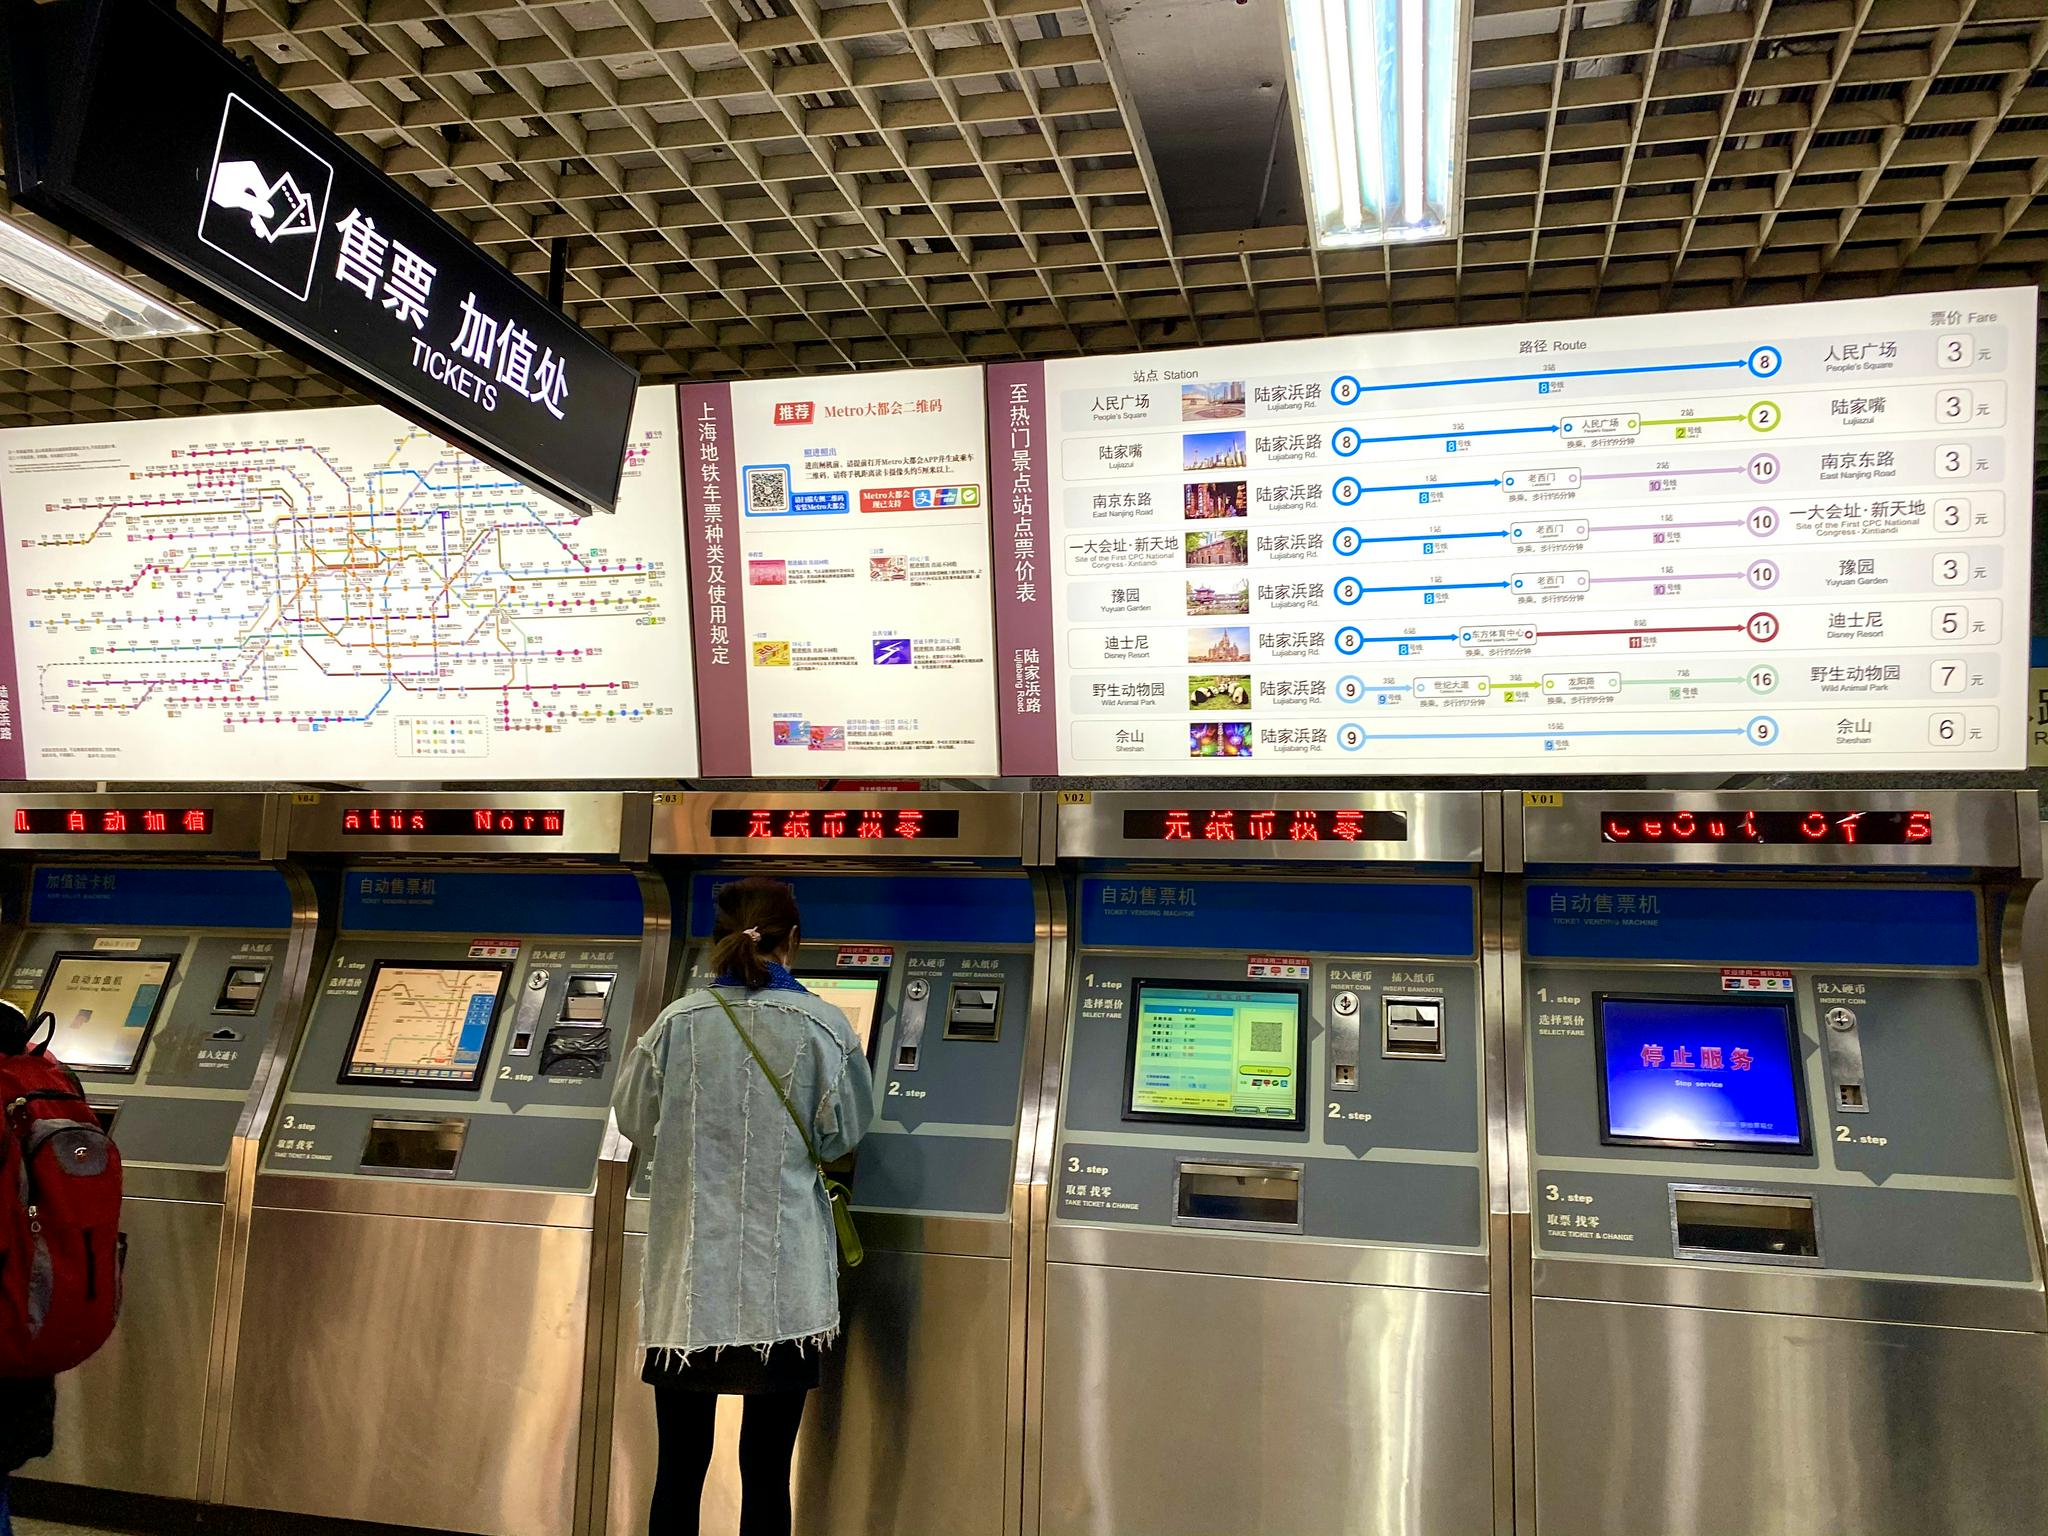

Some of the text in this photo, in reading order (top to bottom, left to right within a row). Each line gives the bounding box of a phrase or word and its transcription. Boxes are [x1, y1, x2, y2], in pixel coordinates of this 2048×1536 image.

[335, 208, 569, 421] 售票 加值处
[1930, 310, 1997, 326] 票价 Fare
[1519, 339, 1587, 354] 路径 Route
[1823, 341, 1897, 362] 人民广场
[1947, 341, 1991, 362] 3 元
[1760, 355, 1769, 369] 8
[411, 336, 498, 412] TICKETS
[1133, 368, 1198, 383] 站点 Station
[1254, 382, 1321, 402] 陆家浜路
[1341, 385, 1350, 396] 8
[824, 398, 943, 419] Metro大都会二维码
[1091, 394, 1150, 412] 人民广场
[1267, 401, 1301, 411] Lujiabang
[1831, 397, 1886, 416] 陆家嘴
[1946, 396, 1990, 417] 3 元
[779, 403, 810, 421] 推荐
[1759, 410, 1769, 424] 2
[1255, 433, 1322, 453] 陆家浜路
[1342, 436, 1351, 448] 8
[1099, 443, 1143, 461] 陆家嘴
[1268, 452, 1302, 462] Lujiabang
[1821, 451, 1896, 470] 南京东路
[1945, 451, 1989, 472] 3 元
[1753, 462, 1772, 476] 10
[863, 489, 911, 500] Metro大都会
[1010, 383, 1037, 603] 至热门景点站点票价表
[1256, 483, 1323, 502] 陆家浜路
[1343, 485, 1352, 498] 8
[1093, 492, 1152, 510] 南京东路
[1269, 501, 1303, 511] Lujiabang
[1753, 515, 1772, 529] 10
[1944, 506, 1988, 527] 3 元
[697, 401, 729, 665] 上海地铁车票种类及使用规定
[1257, 534, 1324, 551] 陆家浜路
[1270, 550, 1303, 560] Lujiabang
[1753, 567, 1772, 581] 10
[1839, 558, 1875, 576] 豫园
[1944, 559, 1987, 580] 3 元
[1112, 588, 1140, 603] 豫园
[1258, 582, 1325, 600] 陆家浜路
[1270, 599, 1304, 609] Lujiabang
[1754, 621, 1770, 635] 11
[1828, 611, 1883, 629] 迪士尼
[1942, 613, 1985, 634] 5 元
[1104, 635, 1149, 650] 迪士尼
[1259, 632, 1325, 649] 陆家浜路
[1272, 648, 1305, 657] Lujiabang
[1023, 648, 1042, 713] 陆家浜路
[1752, 673, 1772, 687] 16
[1810, 664, 1900, 683] 野生动物园
[1941, 667, 1984, 687] 7 元
[1092, 682, 1165, 697] 野生动物园
[1260, 680, 1326, 697] 陆家浜路
[1346, 682, 1355, 696] 9
[1273, 696, 1306, 705] Lujiabang
[1758, 725, 1768, 739] 9
[1836, 718, 1872, 734] 佘山
[1939, 719, 1982, 740] 6 元
[1115, 729, 1145, 743] 佘山
[1347, 731, 1356, 745] 9
[1063, 793, 1085, 802] V02
[1530, 795, 1555, 805] V01
[67, 810, 206, 831] 自动加值
[748, 810, 923, 839] 元纸币找零
[1164, 810, 1364, 841] 元纸币找零
[360, 878, 436, 895] 自动售票机
[1102, 886, 1197, 906] 自动售票机
[1549, 893, 1660, 915] 自动售票机
[1085, 974, 1123, 990] 1. step
[1330, 969, 1373, 983] 投入硬币
[1391, 972, 1436, 983] 插入纸币
[1407, 986, 1443, 994] BANKNOTE
[1536, 988, 1581, 1006] 1. step
[1817, 982, 1866, 996] 投入硬币
[1083, 998, 1124, 1009] 选择票价
[1819, 997, 1846, 1005] INSERT
[1538, 1014, 1585, 1027] 选择票价
[1640, 1044, 1754, 1071] 停止服务
[500, 1066, 533, 1082] 2. step
[889, 1081, 927, 1099] 2. step
[1675, 1080, 1724, 1089] Stop service
[1328, 1102, 1372, 1122] 2. step
[1068, 1157, 1109, 1175] 3. step
[1066, 1184, 1112, 1197] 取票 找零
[1083, 1200, 1105, 1208] TICKET
[1111, 1202, 1139, 1210] CHANGE
[1547, 1213, 1600, 1228] 取票 找零
[1567, 1230, 1595, 1238] TICKET
[1602, 1232, 1634, 1241] CHANGE
